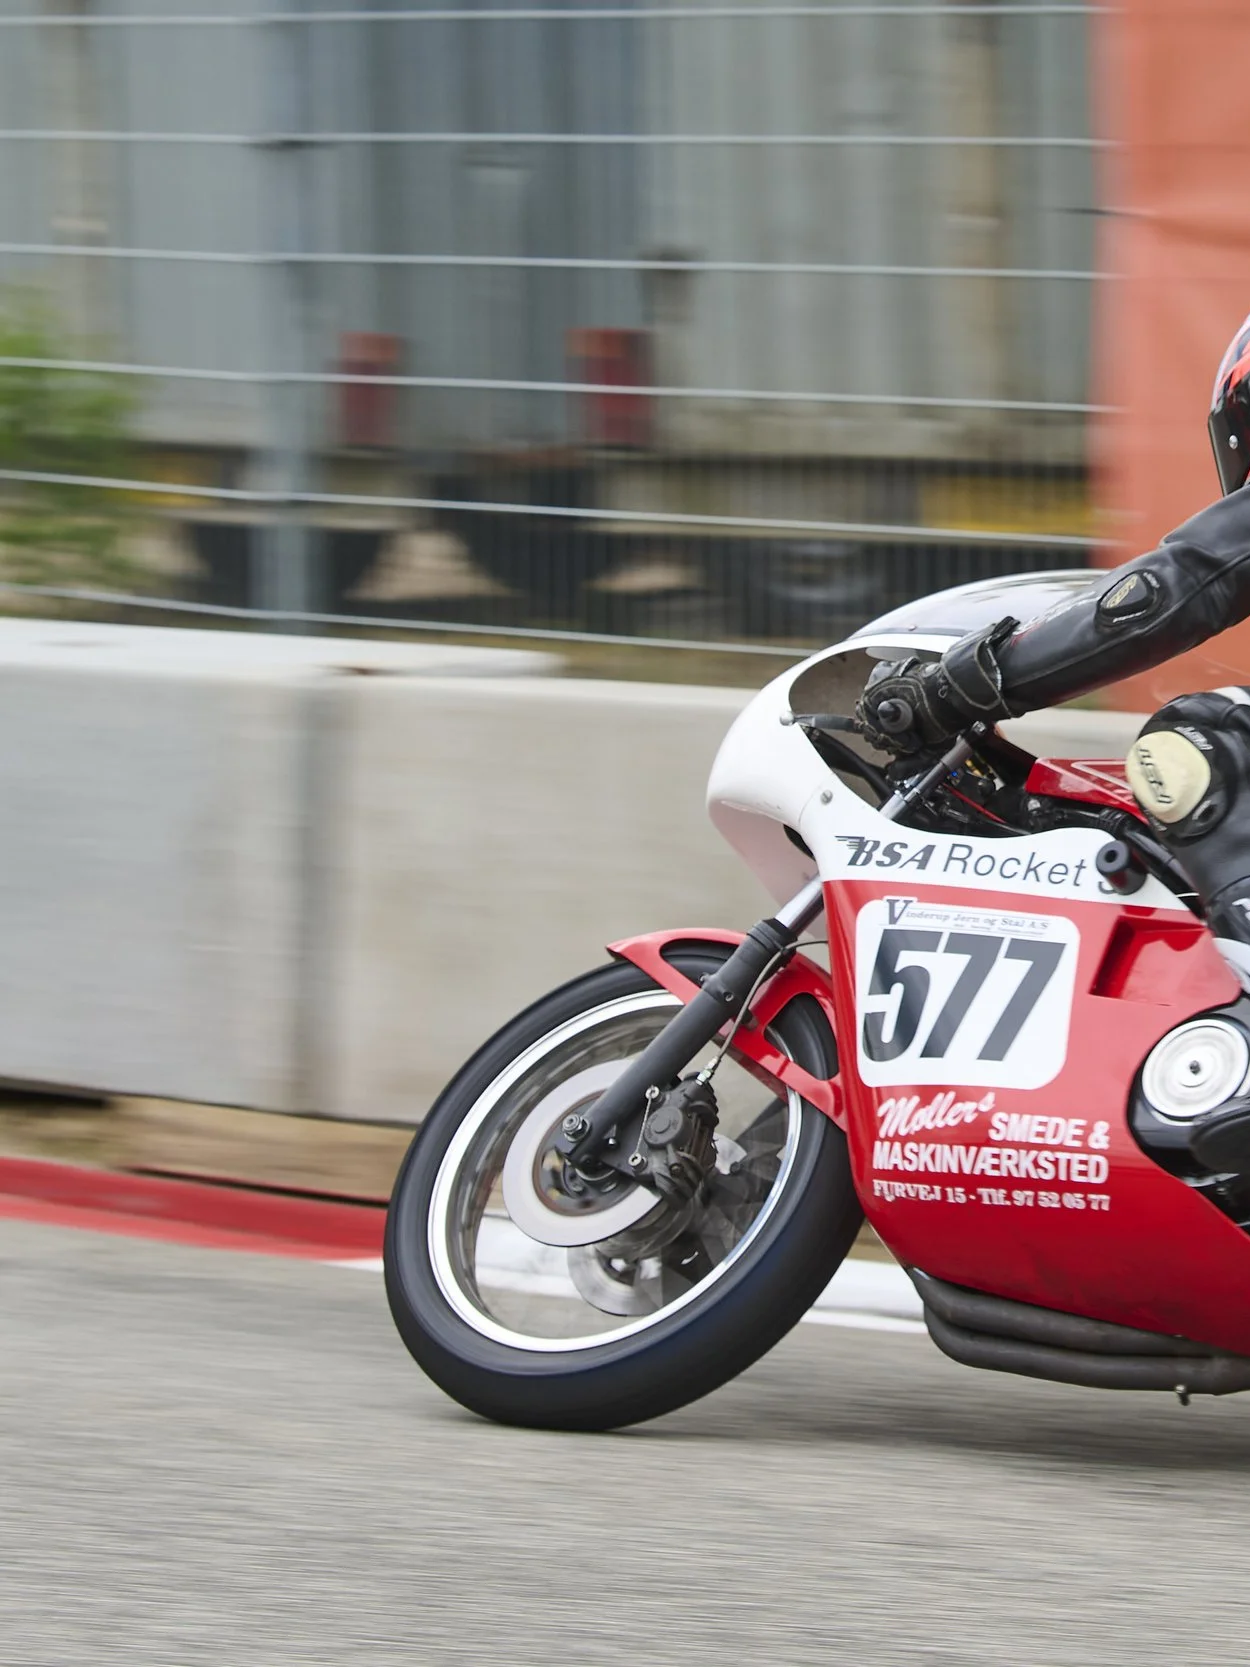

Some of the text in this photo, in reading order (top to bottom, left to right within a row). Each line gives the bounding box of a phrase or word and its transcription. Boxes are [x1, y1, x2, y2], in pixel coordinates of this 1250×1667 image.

[835, 835, 1087, 887] BSA Rocket
[862, 929, 1067, 1063] 577
[988, 1111, 1110, 1150] SMEDE &
[872, 1140, 1109, 1184] MASKINVÆRKSTED
[945, 1186, 967, 1204] 15
[1011, 1190, 1035, 1207] 97
[1037, 1191, 1061, 1208] 52
[1087, 1194, 1111, 1211] 77
